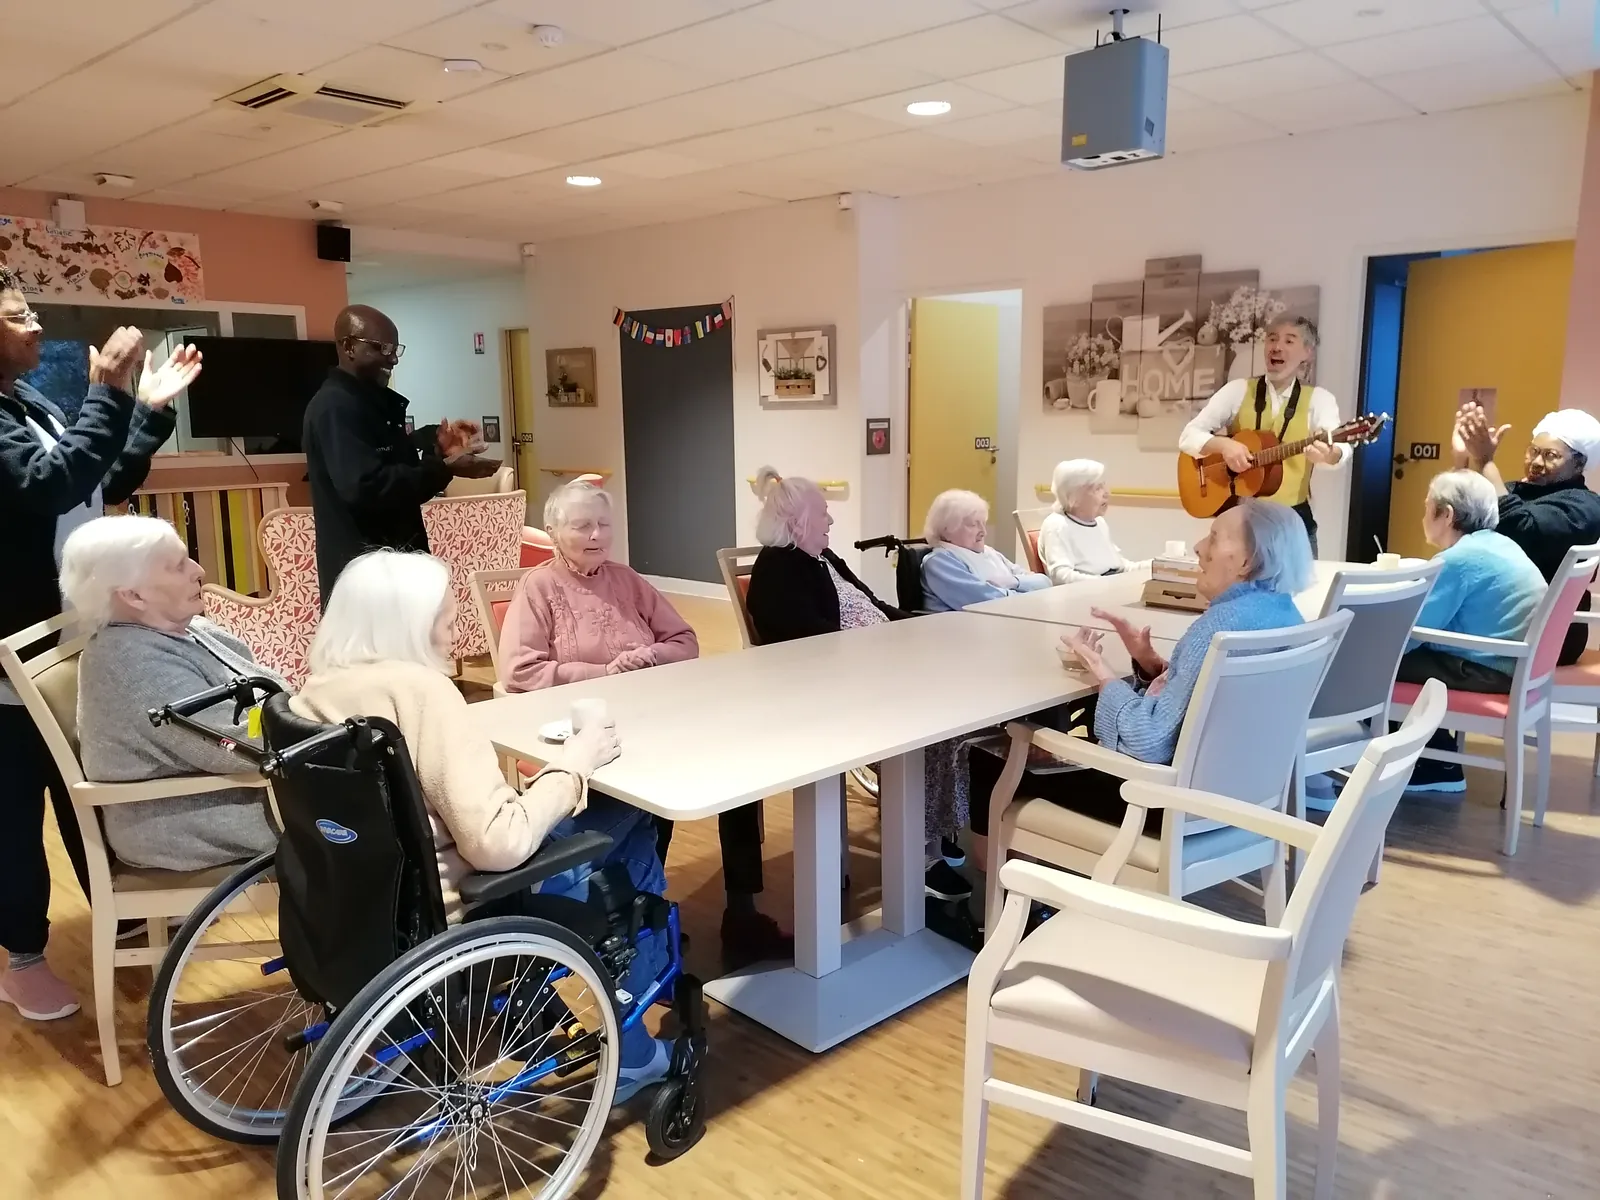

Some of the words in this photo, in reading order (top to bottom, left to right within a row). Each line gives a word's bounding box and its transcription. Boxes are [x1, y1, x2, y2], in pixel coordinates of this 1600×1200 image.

[1122, 364, 1215, 398] HOME
[976, 438, 989, 448] 003
[1413, 444, 1437, 458] 001
